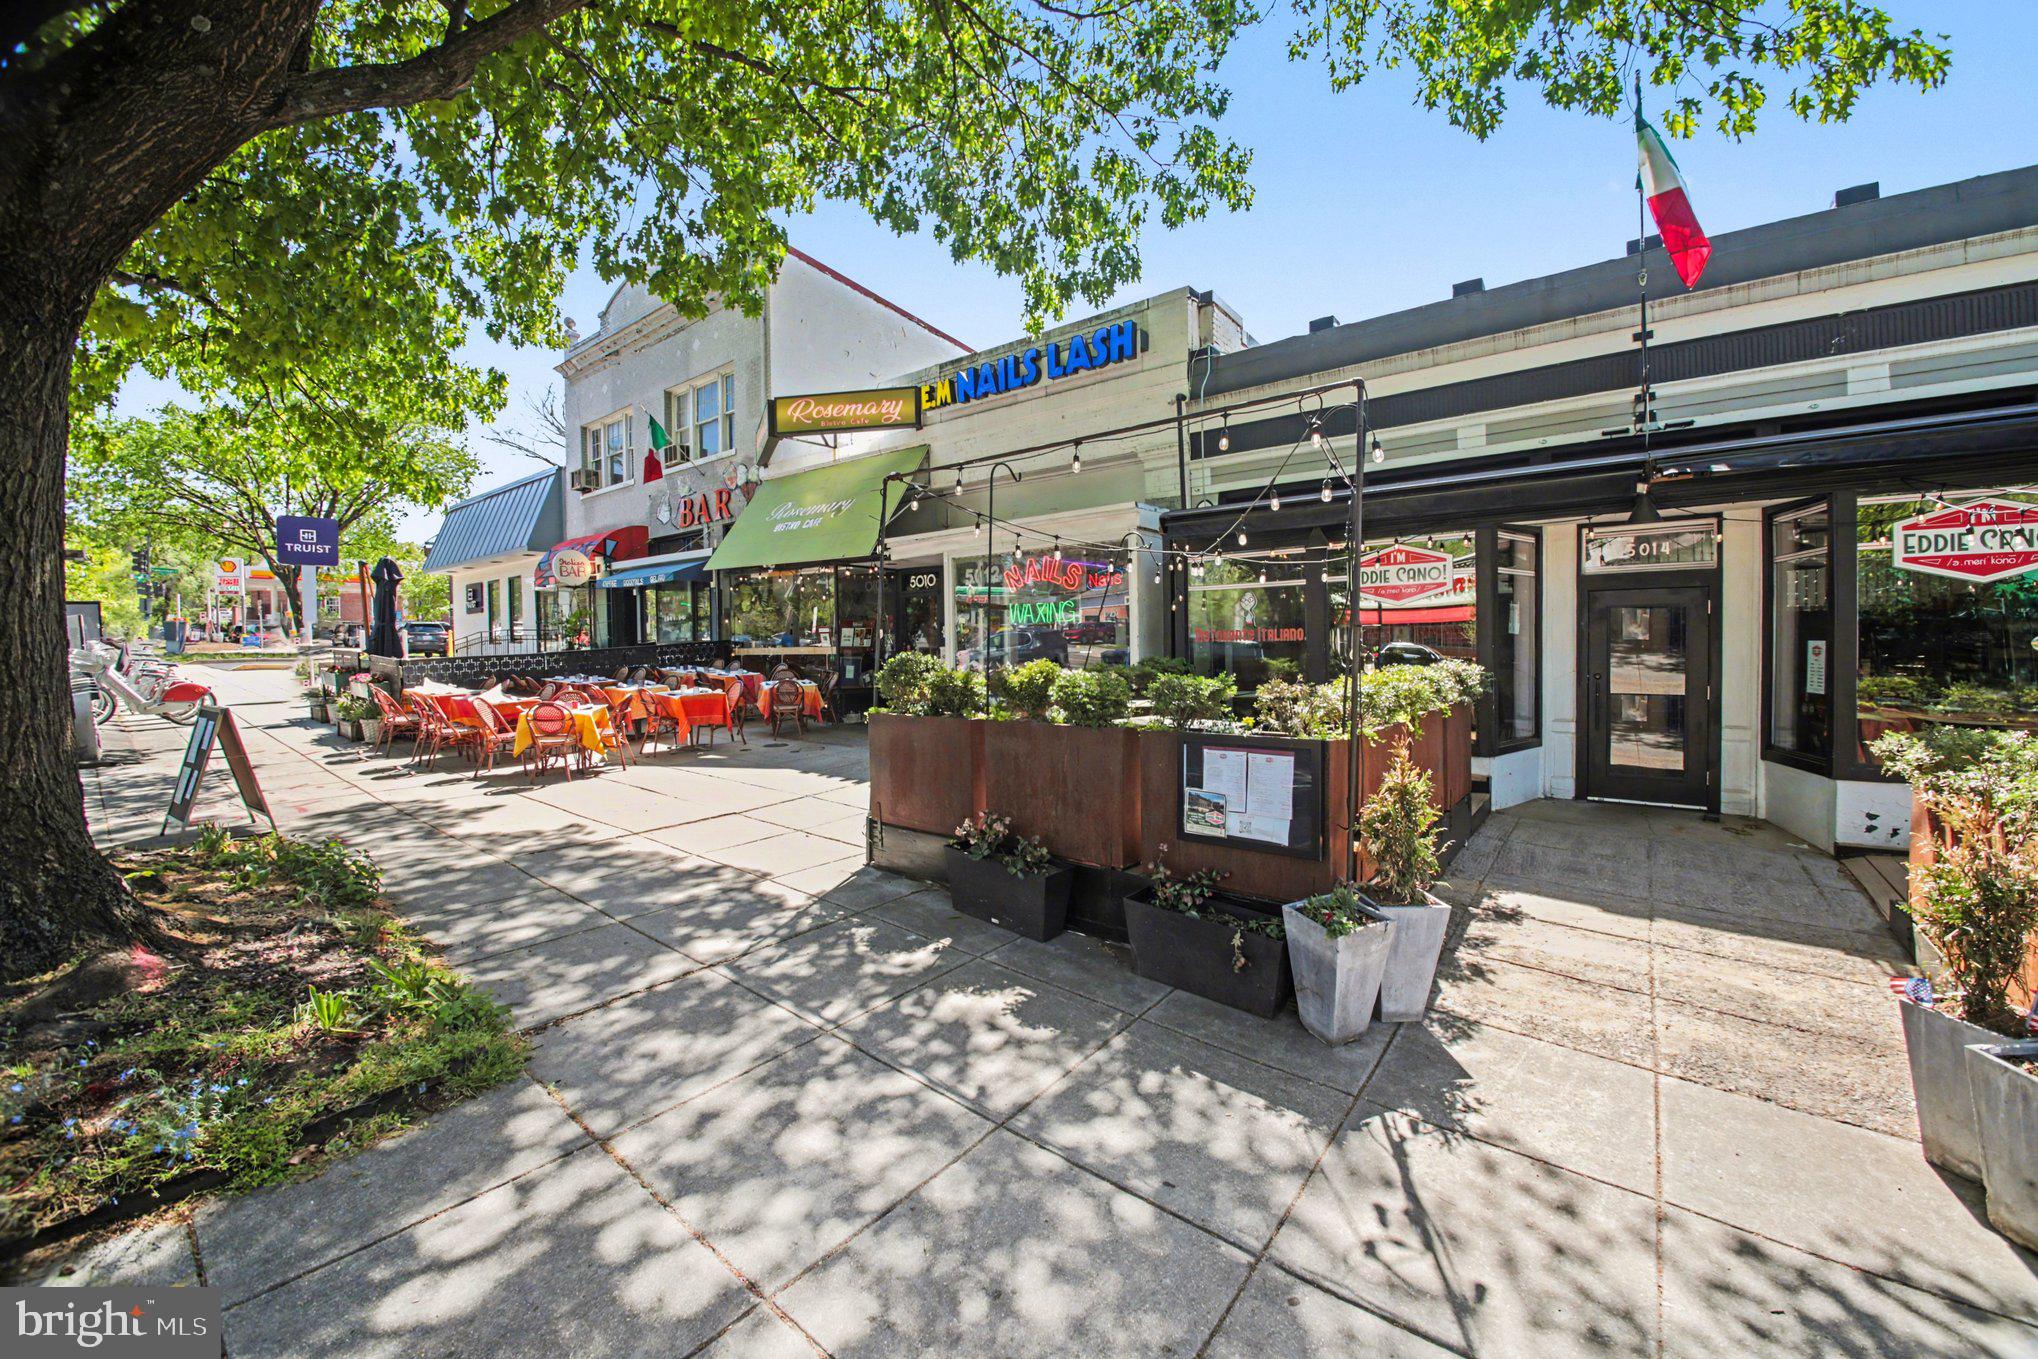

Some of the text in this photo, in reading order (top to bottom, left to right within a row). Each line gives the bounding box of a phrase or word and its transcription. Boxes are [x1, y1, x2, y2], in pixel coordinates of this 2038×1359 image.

[957, 347, 1041, 404] NAILS
[1048, 320, 1137, 379] LASH
[787, 399, 903, 423] Rosemary
[680, 488, 733, 529] BAR
[284, 543, 331, 554] TRUIST
[1628, 541, 1671, 557] 5014
[1903, 528, 2038, 555] EDDIE CAN
[1390, 551, 1406, 564] I'M
[559, 566, 586, 578] BAR
[909, 573, 937, 589] 5010
[1004, 555, 1082, 593] NAILS
[1361, 564, 1447, 585] DDIE CANO!
[1009, 600, 1076, 624] WAXING
